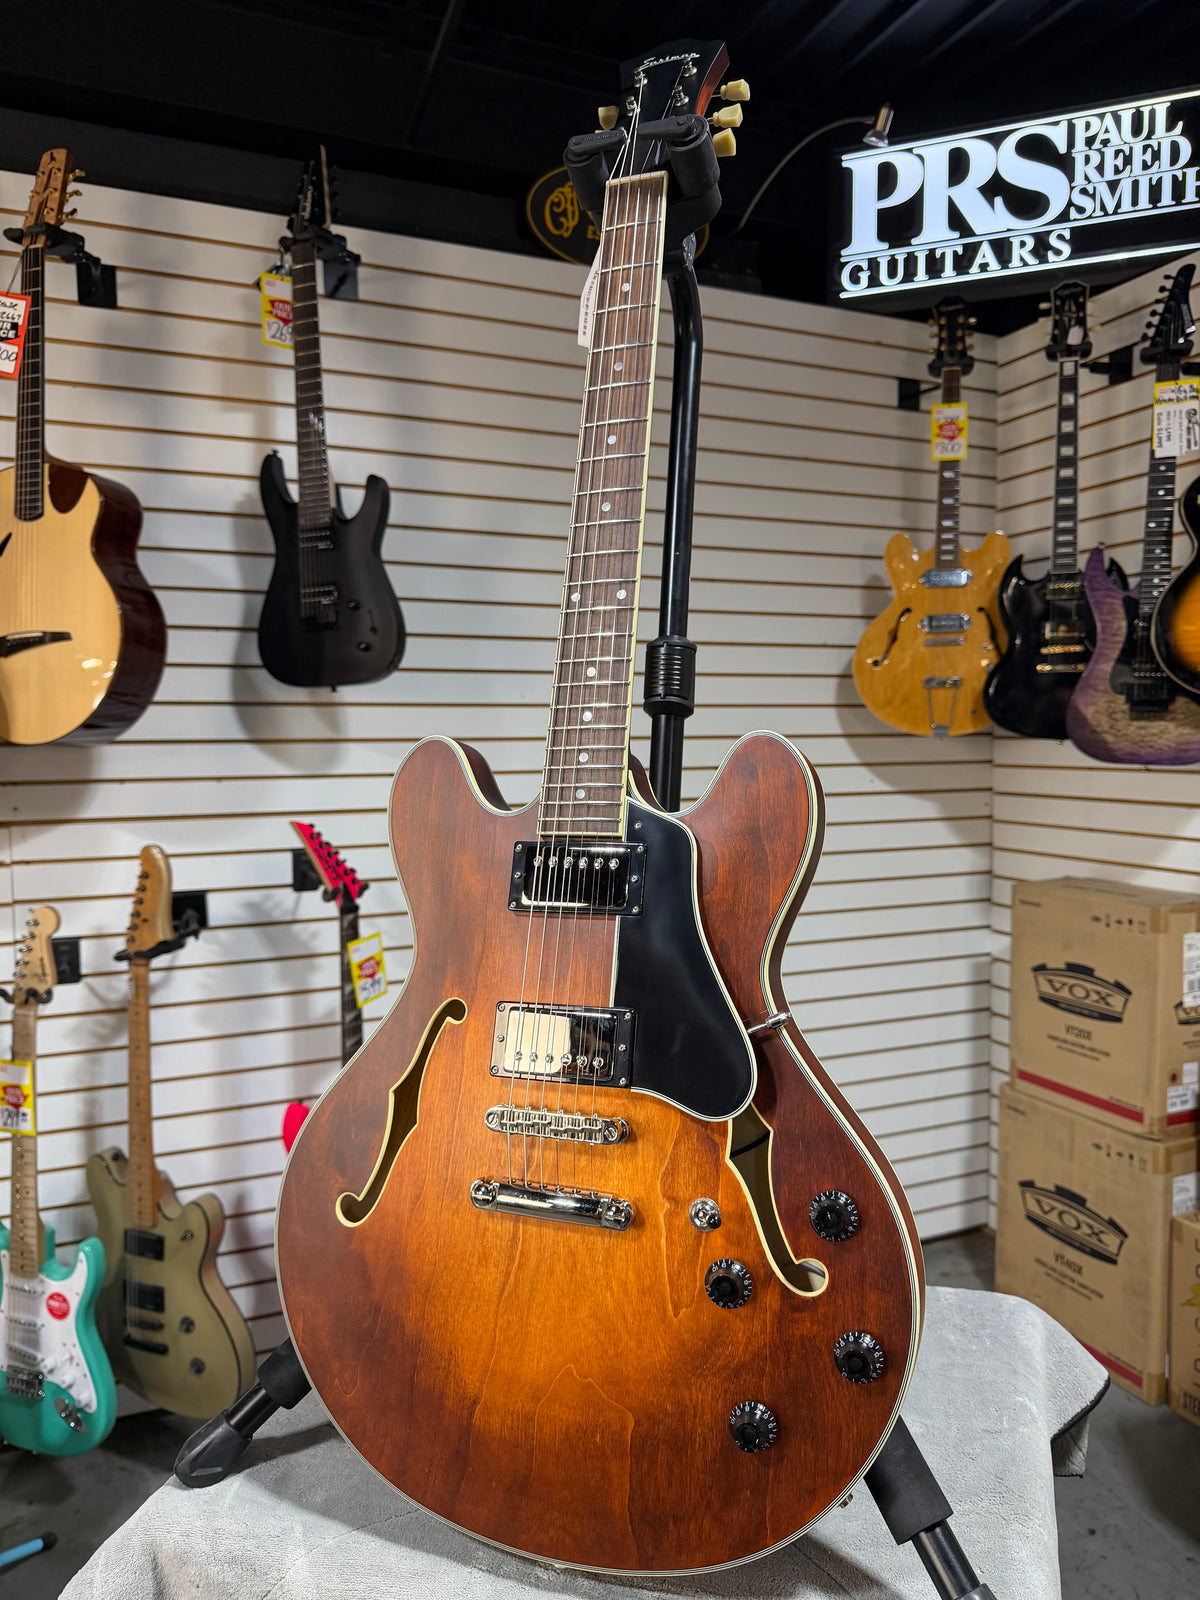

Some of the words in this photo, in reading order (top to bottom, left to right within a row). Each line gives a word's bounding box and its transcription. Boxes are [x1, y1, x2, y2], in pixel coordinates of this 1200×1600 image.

[1071, 102, 1184, 153] PAUL
[1071, 136, 1192, 187] REED
[841, 120, 1070, 256] PRS
[840, 229, 1072, 292] GUITARS
[1043, 976, 1115, 1008] VOX
[1032, 1196, 1111, 1248] VOX
